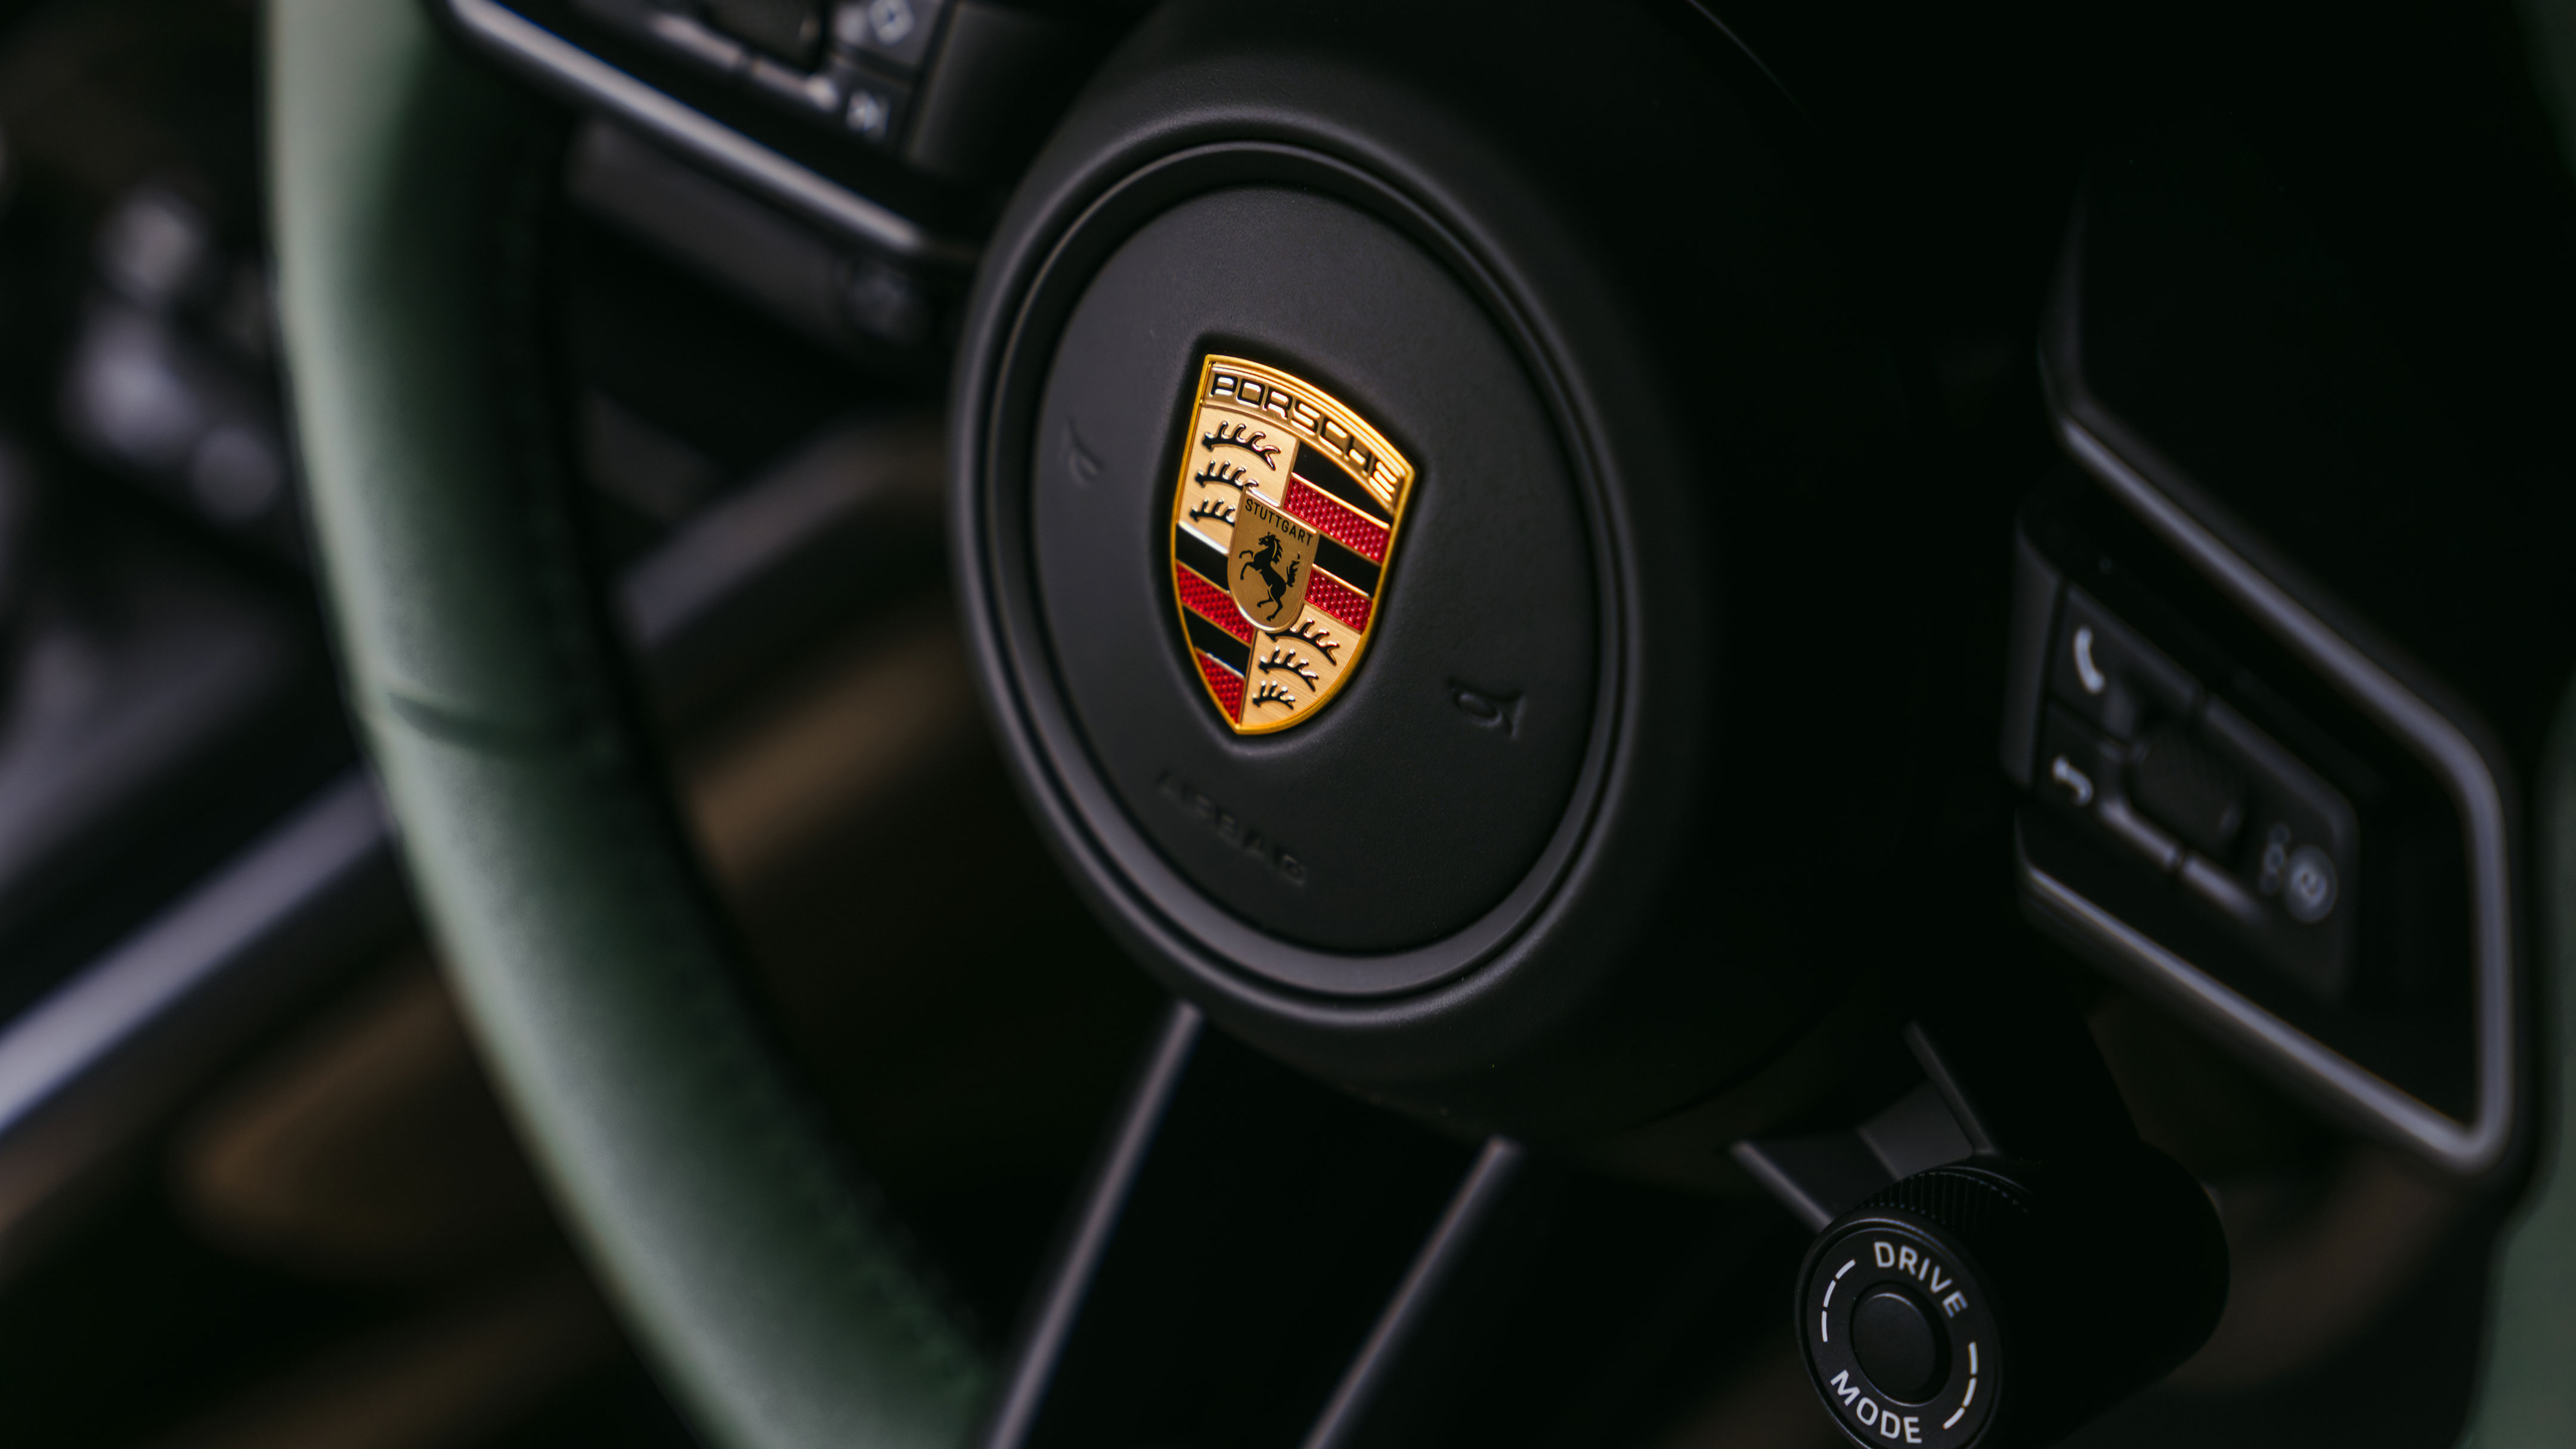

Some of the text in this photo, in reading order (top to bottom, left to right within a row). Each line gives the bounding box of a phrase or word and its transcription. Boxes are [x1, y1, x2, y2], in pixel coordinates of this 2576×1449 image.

[1209, 373, 1398, 503] PORSCHE
[1244, 498, 1313, 546] STUTTGART
[1874, 1241, 1968, 1318] DRIVE
[1830, 1369, 1922, 1444] MODE
